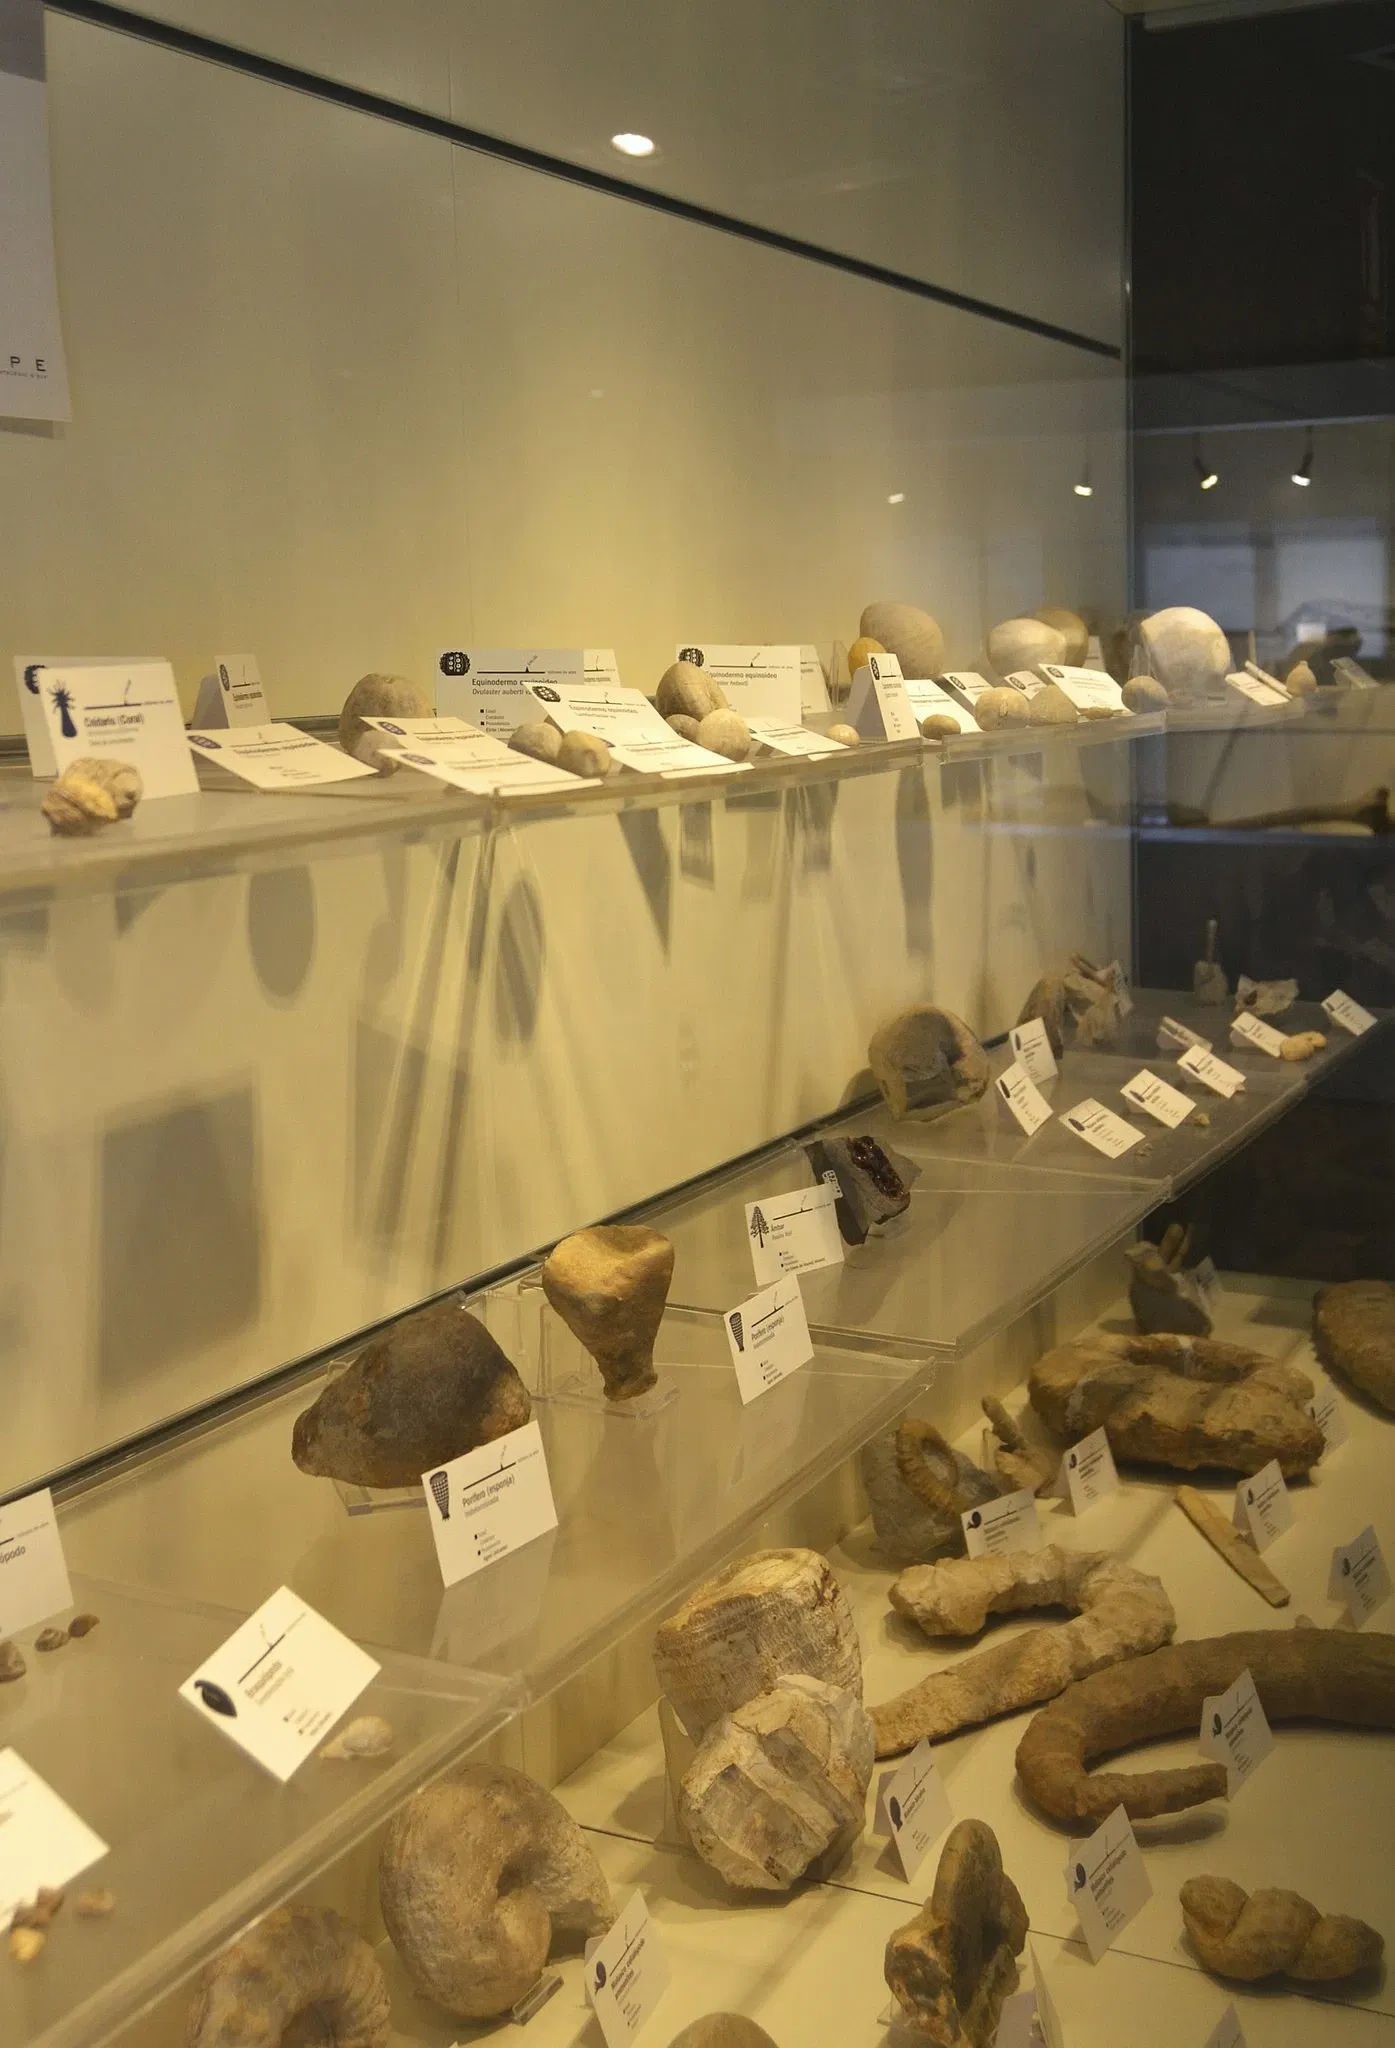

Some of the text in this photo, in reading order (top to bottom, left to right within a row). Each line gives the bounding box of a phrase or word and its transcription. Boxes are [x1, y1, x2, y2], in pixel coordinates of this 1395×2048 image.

[745, 671, 777, 680] equinoideo
[472, 678, 518, 688] Equinodermo
[485, 1474, 515, 1497] (esponja)
